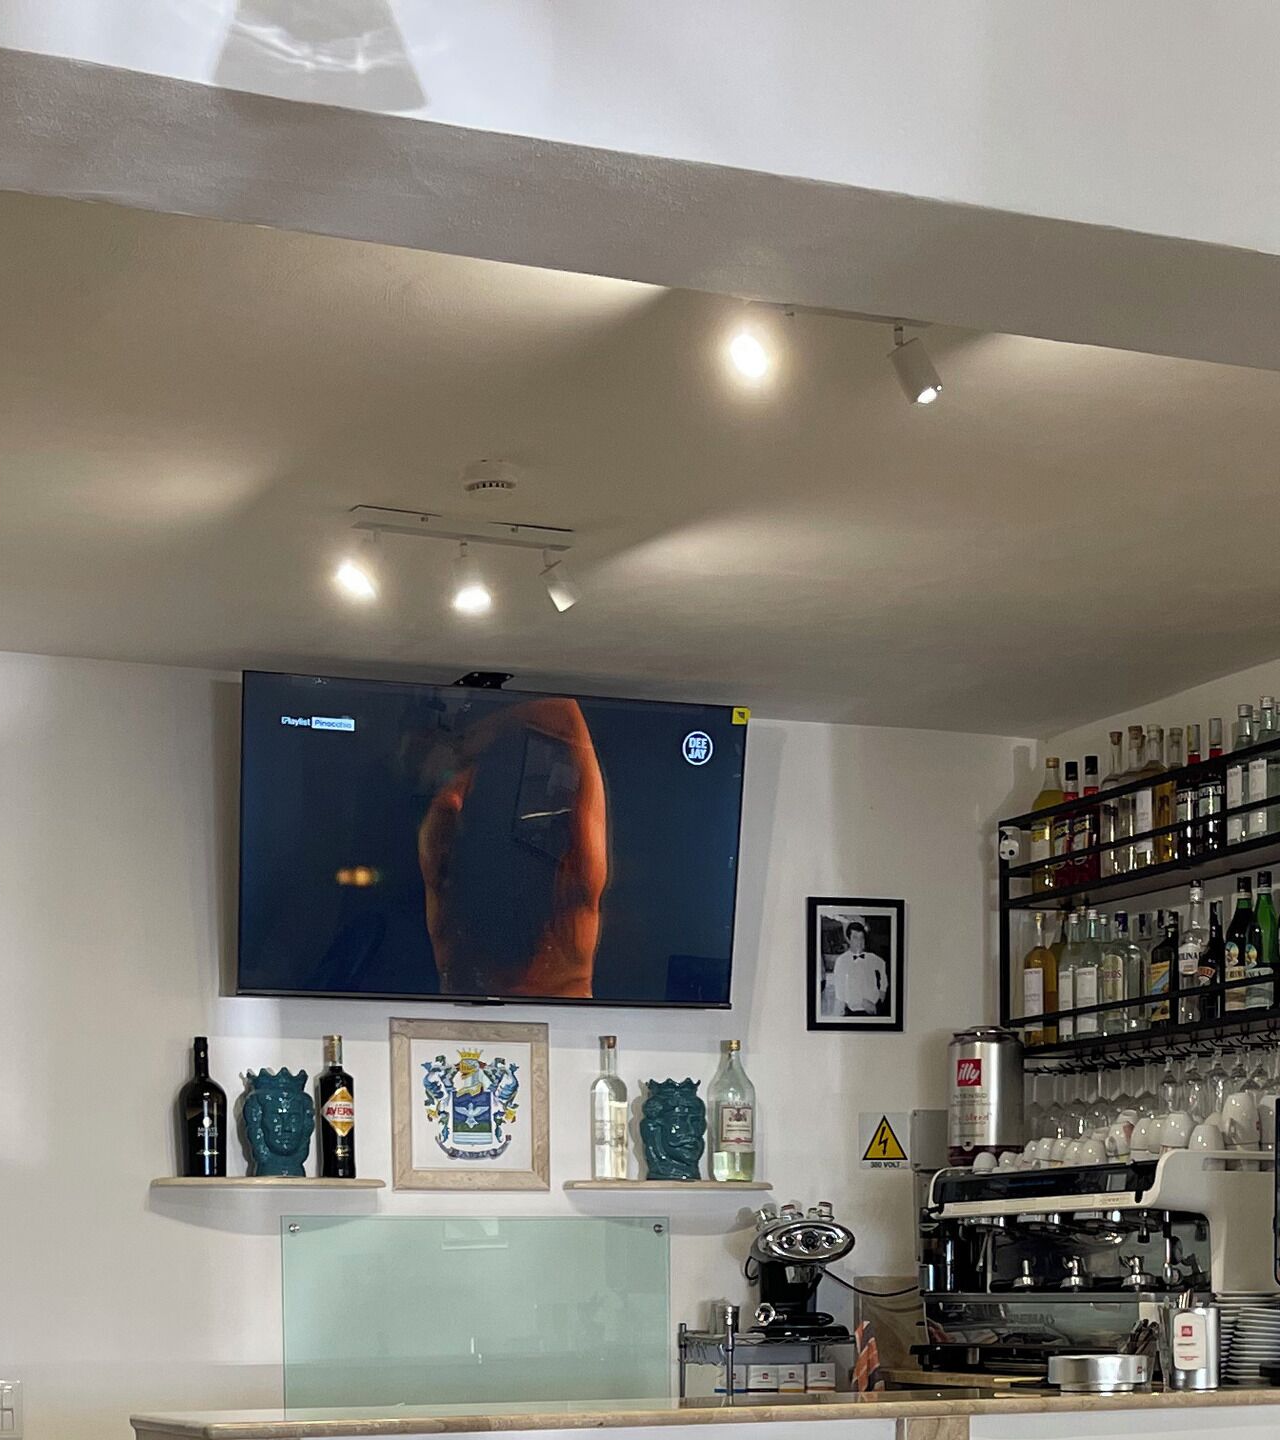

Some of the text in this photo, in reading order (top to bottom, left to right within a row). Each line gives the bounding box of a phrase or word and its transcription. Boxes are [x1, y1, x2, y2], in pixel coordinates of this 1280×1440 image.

[688, 737, 708, 748] DEE
[688, 748, 707, 759] JAY
[958, 1062, 980, 1085] illy
